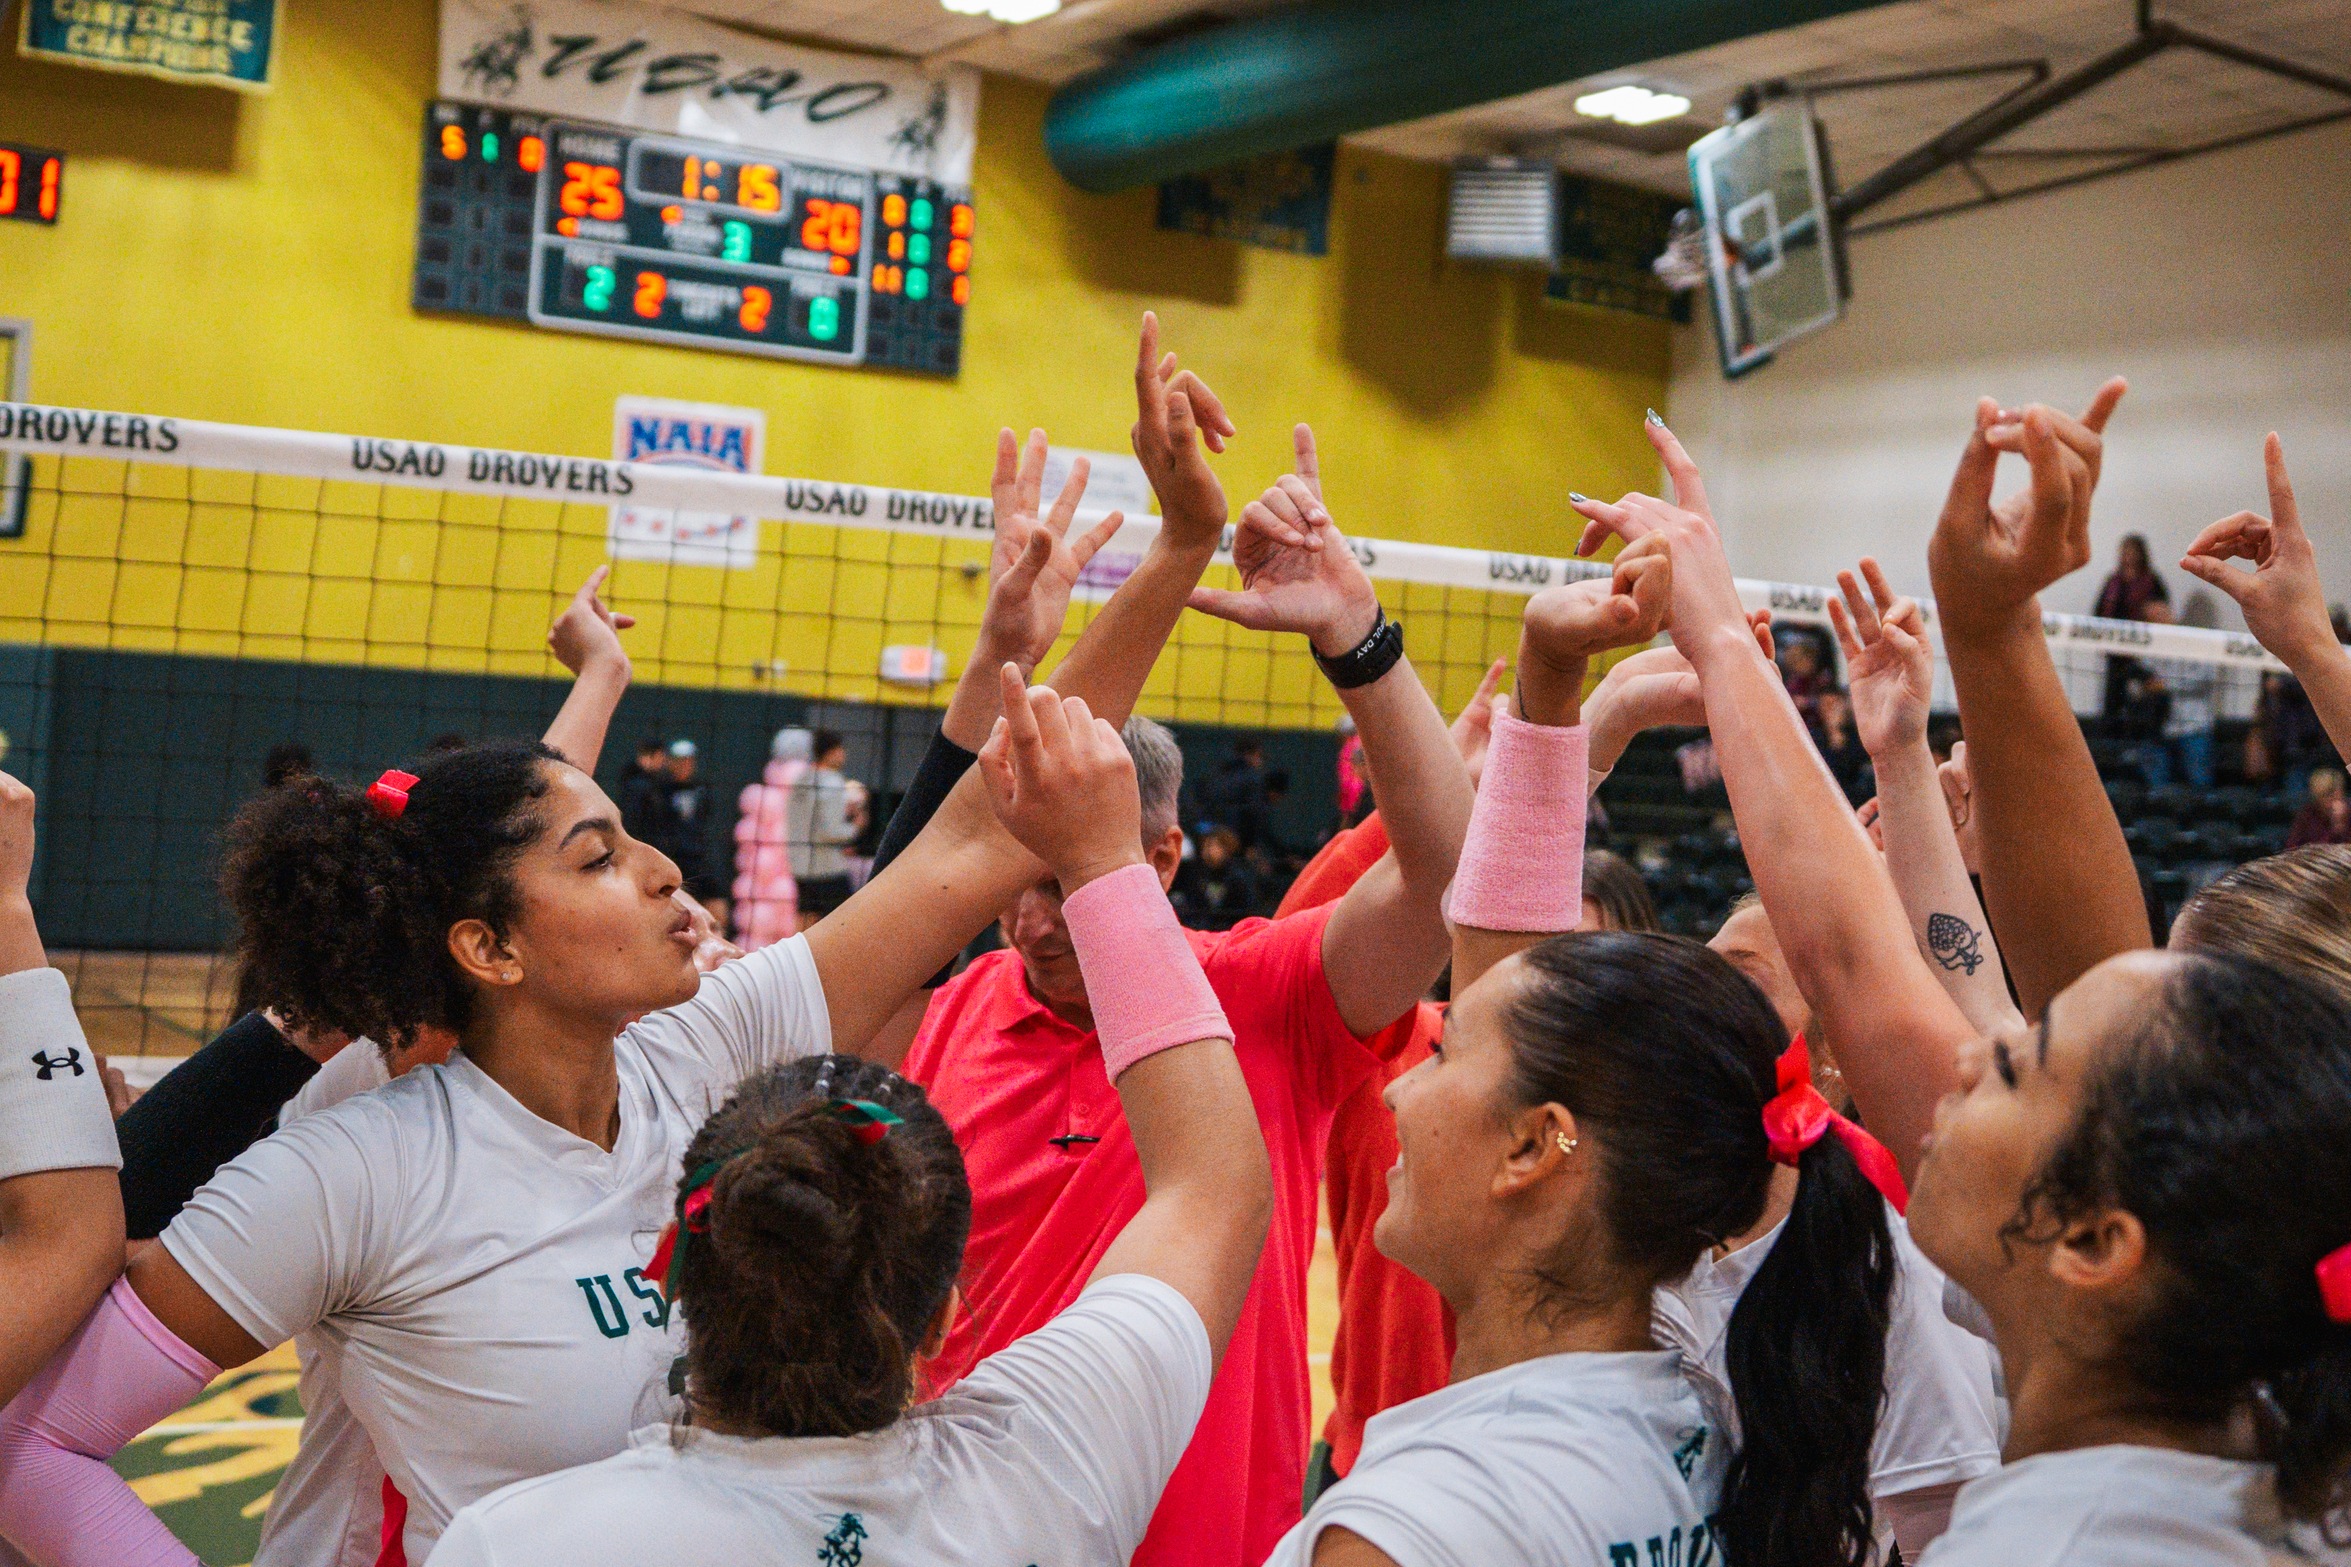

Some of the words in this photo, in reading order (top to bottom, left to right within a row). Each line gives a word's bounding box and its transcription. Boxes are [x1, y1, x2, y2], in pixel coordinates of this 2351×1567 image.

[559, 161, 625, 221] 25
[722, 220, 752, 264] 3
[801, 198, 862, 256] 20
[583, 265, 616, 312] 2
[633, 271, 667, 319] 2
[739, 285, 772, 333] 2
[352, 437, 446, 478] USAO
[467, 450, 635, 496] DROVERS
[628, 415, 747, 473] NAIA
[784, 481, 867, 517] USAO
[887, 491, 995, 530] DROVE
[1356, 639, 1375, 659] DAY
[575, 1266, 667, 1339] US
